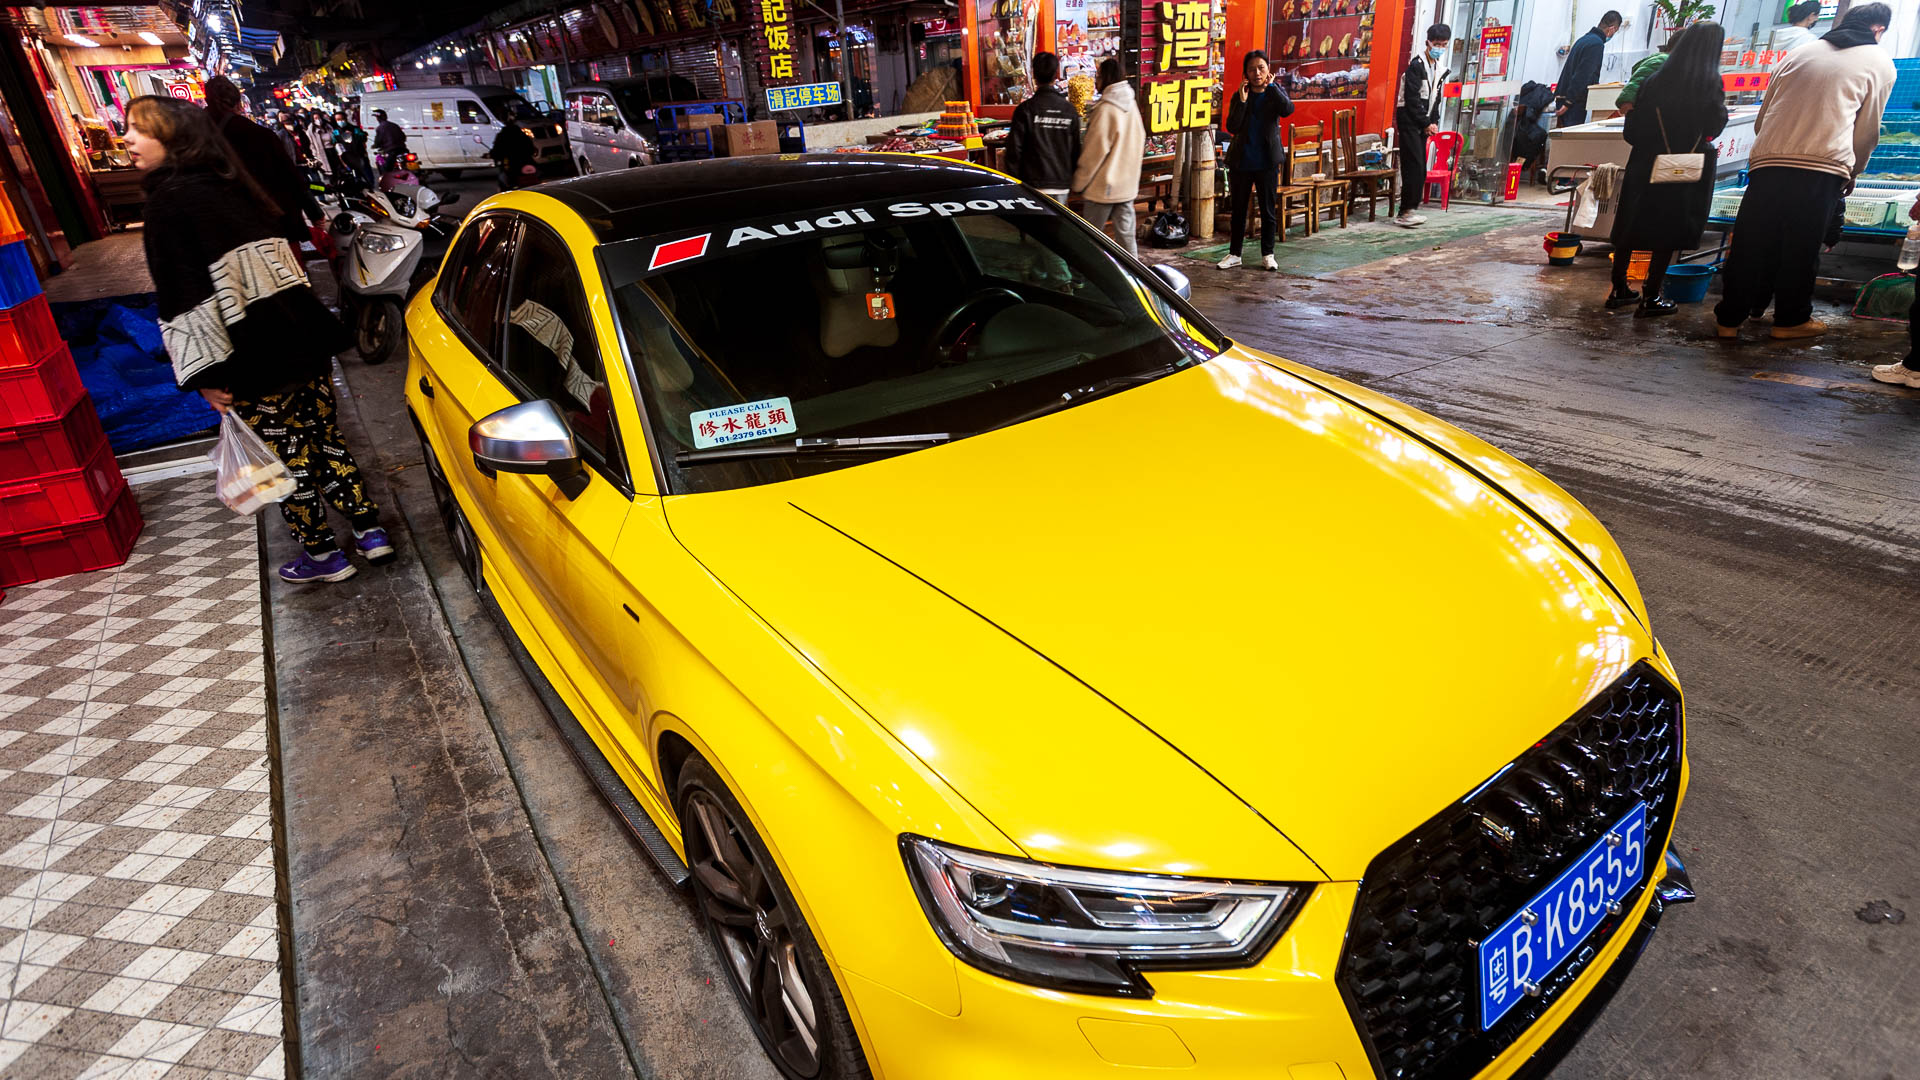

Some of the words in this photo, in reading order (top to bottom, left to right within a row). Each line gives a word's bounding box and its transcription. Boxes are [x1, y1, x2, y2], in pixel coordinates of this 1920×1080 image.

[1160, 1, 1210, 71] 湾
[769, 84, 839, 109] 滑記停车场
[1149, 76, 1213, 133] 饭店
[727, 207, 875, 248] Audi
[888, 197, 1043, 217] Sport
[699, 408, 789, 438] 修水龍頭
[709, 407, 745, 418] PLEASE
[748, 402, 772, 412] CALL
[756, 427, 778, 436] 6511
